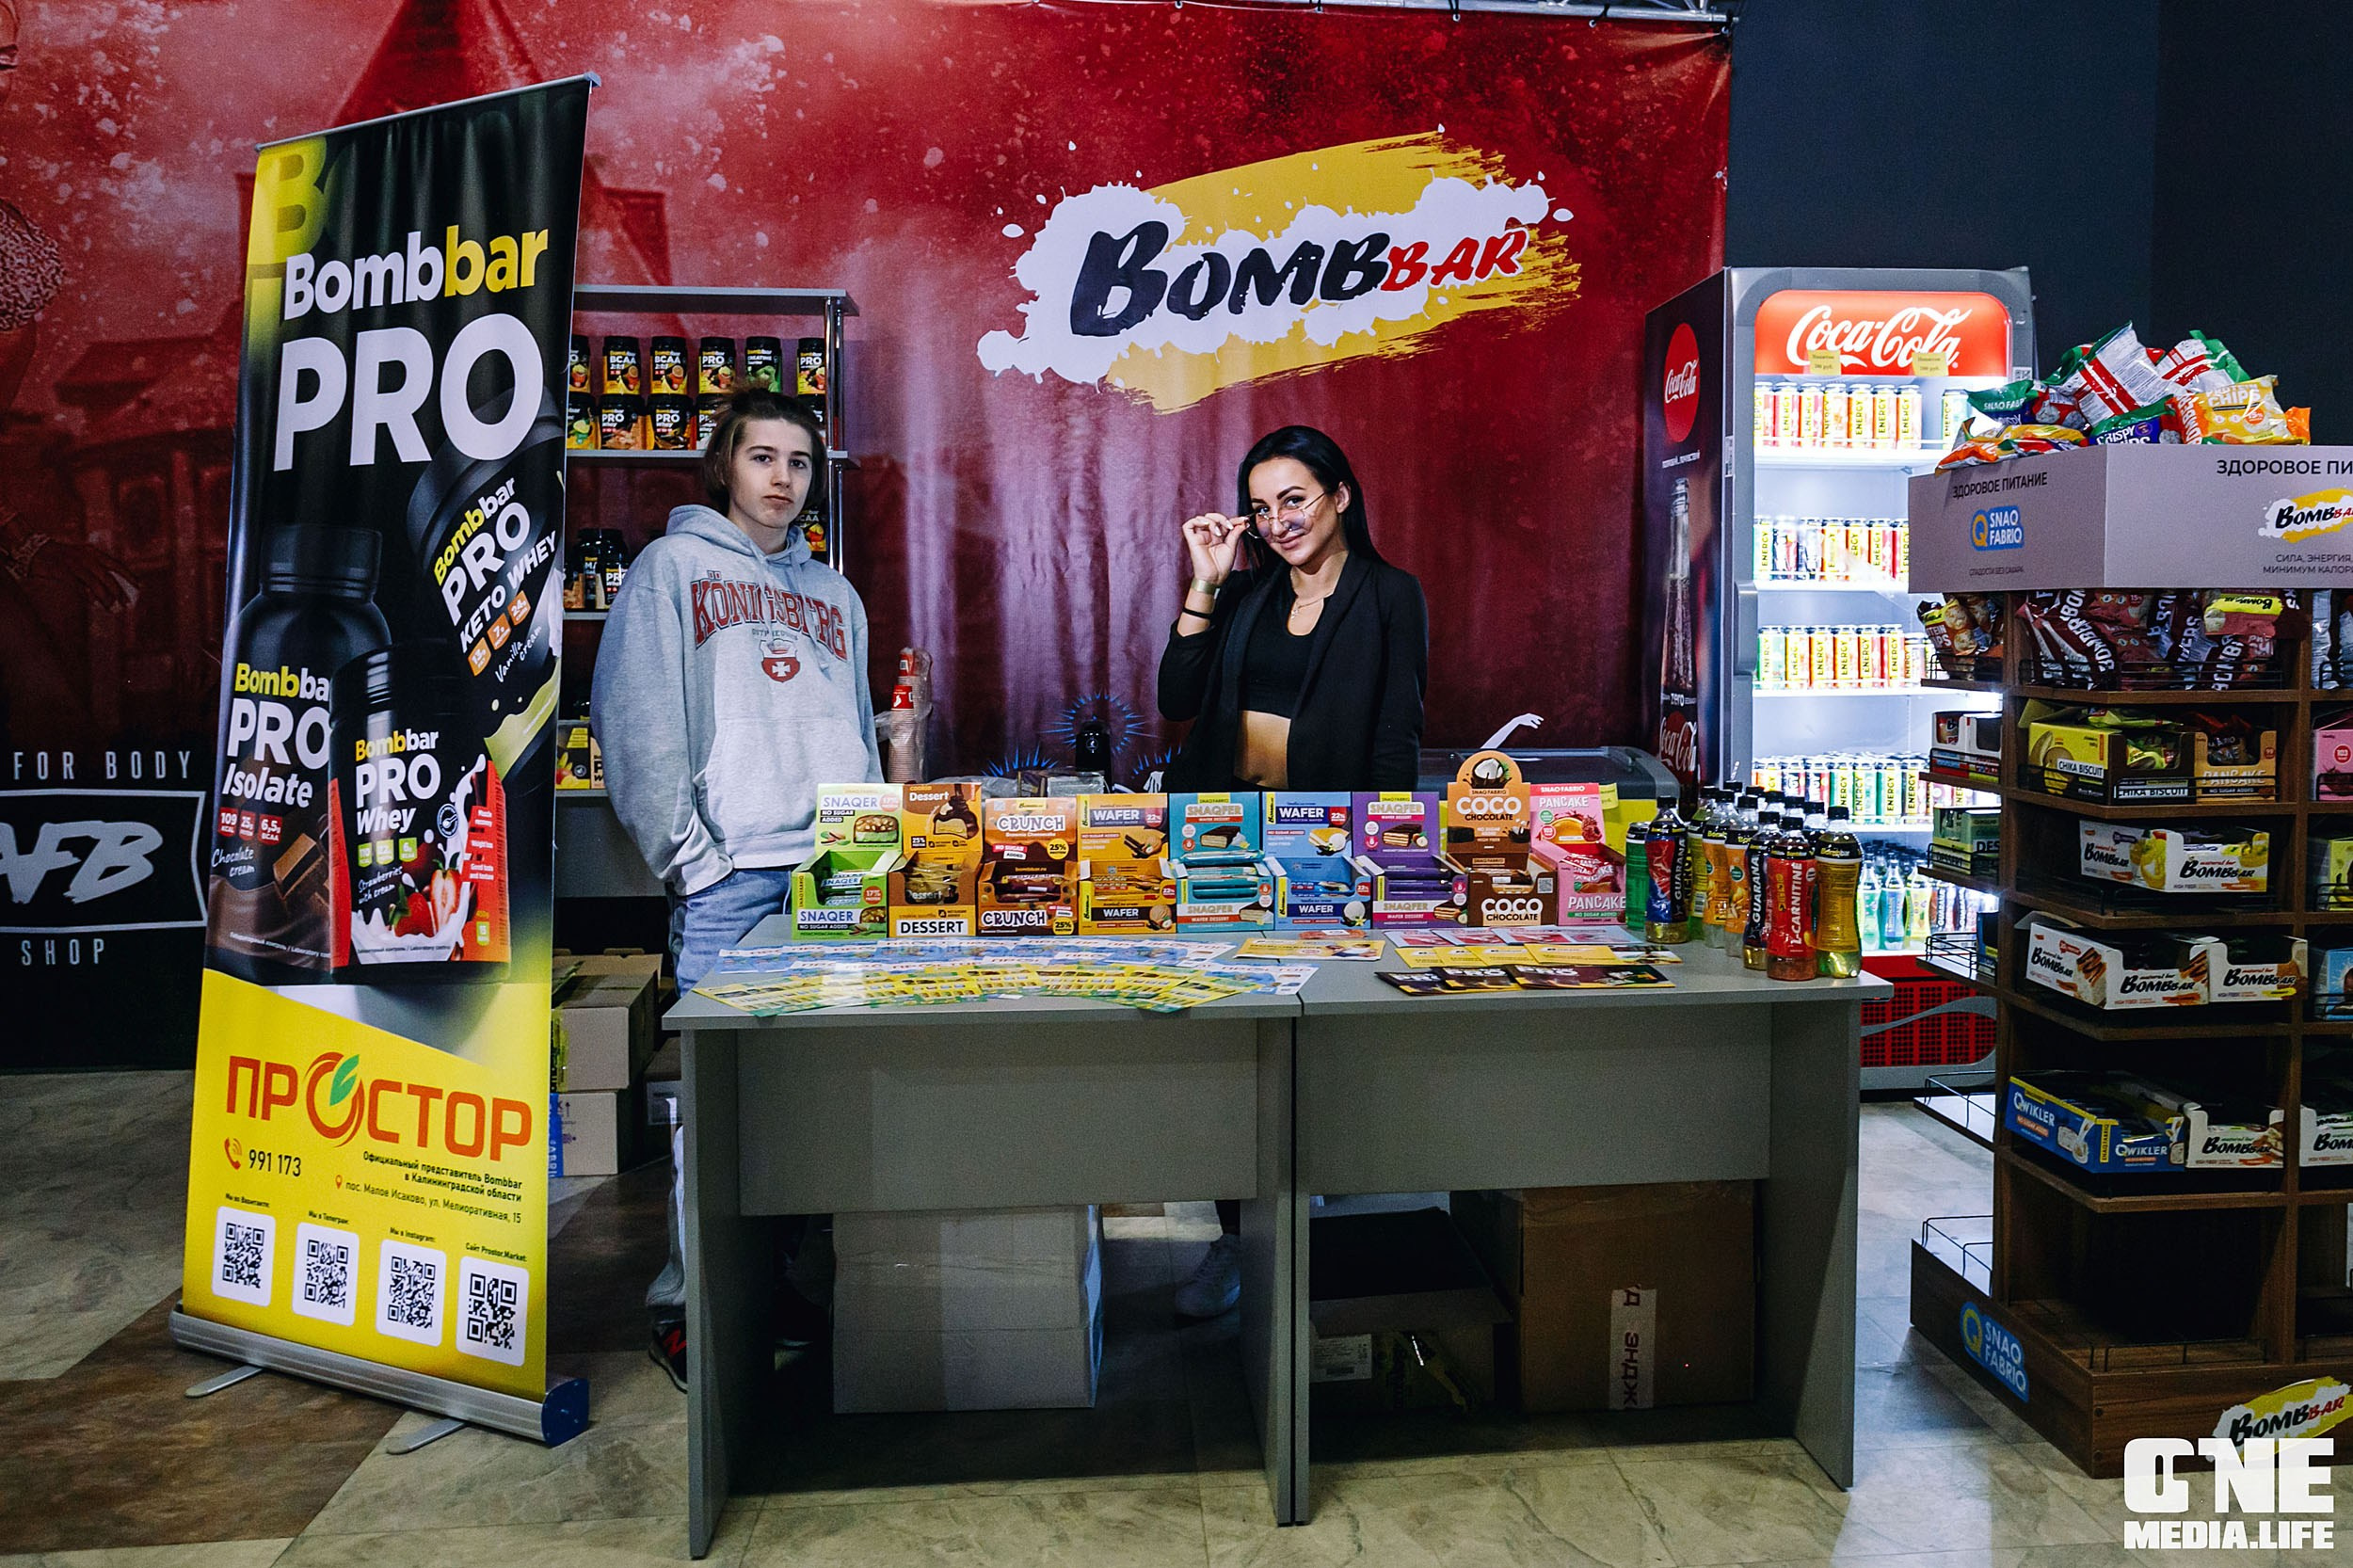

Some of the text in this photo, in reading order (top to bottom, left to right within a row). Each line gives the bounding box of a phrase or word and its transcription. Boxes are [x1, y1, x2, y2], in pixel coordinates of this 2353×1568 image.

[284, 224, 549, 321] Bombbar
[1069, 219, 1529, 337] BOMBBAR
[1785, 304, 1973, 368] Coca-Cola
[610, 356, 636, 364] BCAA
[654, 356, 680, 364] BCAA
[702, 356, 725, 364] PRO
[800, 357, 822, 365] PRO
[1664, 357, 1700, 404] Coca-Cola
[274, 312, 544, 472] PRO
[2207, 391, 2260, 407] CHIPS
[602, 414, 625, 423] PRO
[656, 414, 680, 423] PRO
[1855, 400, 1864, 436] ENERGY
[1878, 398, 1886, 434] ENERGY
[2216, 459, 2353, 477] ЗДОРОВОЕ ПИ
[1952, 472, 2048, 500] ЗДОРОВОЕ ПИТАНИЕ
[434, 477, 516, 586] Bombbar
[441, 502, 531, 627] PRO
[2263, 566, 2315, 574] МИНИМУМ
[459, 530, 556, 654] KETO WHEY
[495, 641, 523, 683] Vanilla
[1862, 638, 1870, 673] ENERGY
[234, 662, 329, 701] Bombba
[227, 697, 329, 770] PRO
[355, 728, 440, 762] Bombbar
[12, 750, 191, 780] FOR BODY
[2058, 760, 2104, 776] CHIKA BISCUIT
[221, 762, 313, 808] Isolate
[355, 753, 441, 809] PRO
[2201, 770, 2265, 785] PANCAKE
[909, 792, 950, 802] Dessert
[1886, 776, 1895, 812] ENERGY
[1908, 773, 1916, 810] ENERGY
[823, 796, 878, 808] SNAQER
[1188, 805, 1242, 816] SNAQFER
[1369, 804, 1423, 814] SNAQFER
[1456, 796, 1522, 815] COCO
[1539, 796, 1590, 808] PANCAKE
[220, 812, 237, 825] 109
[357, 807, 417, 836] Whey
[1093, 809, 1140, 822] WAFER
[1279, 808, 1324, 818] WAFER
[998, 816, 1064, 831] CRUNCH
[211, 846, 255, 869] Chocolate
[1674, 838, 1686, 901] GUARANA
[2180, 859, 2255, 878] BOMBBAR
[1752, 855, 1761, 923] GUARANA
[1188, 904, 1234, 914] SNAQFER
[1299, 904, 1334, 913] WAFER
[1384, 903, 1428, 911] SNAQFER
[1481, 898, 1544, 914] COCO
[1568, 895, 1627, 910] PANCAKE
[1790, 861, 1803, 946] L-CARNITINE
[800, 910, 854, 921] SNAQER
[983, 911, 1046, 925] CRUNCH
[1103, 908, 1139, 918] WAFER
[1486, 913, 1538, 921] CHOCOLATE
[901, 920, 965, 934] DESSERT
[21, 938, 105, 966] SHOP
[2121, 975, 2195, 994] BOMBBAR
[226, 1051, 533, 1162] ПРОСТОР
[2013, 1091, 2056, 1128] QWIKLER
[2115, 1144, 2168, 1157] QWIKLER
[248, 1149, 301, 1176] 991 173
[363, 1151, 522, 1190] Официальный представитель Bombbar
[411, 1172, 485, 1196] Калининградской
[487, 1187, 521, 1202] области
[345, 1182, 521, 1224] пос. Малое Исаково, ул. Мелиоративная, 15
